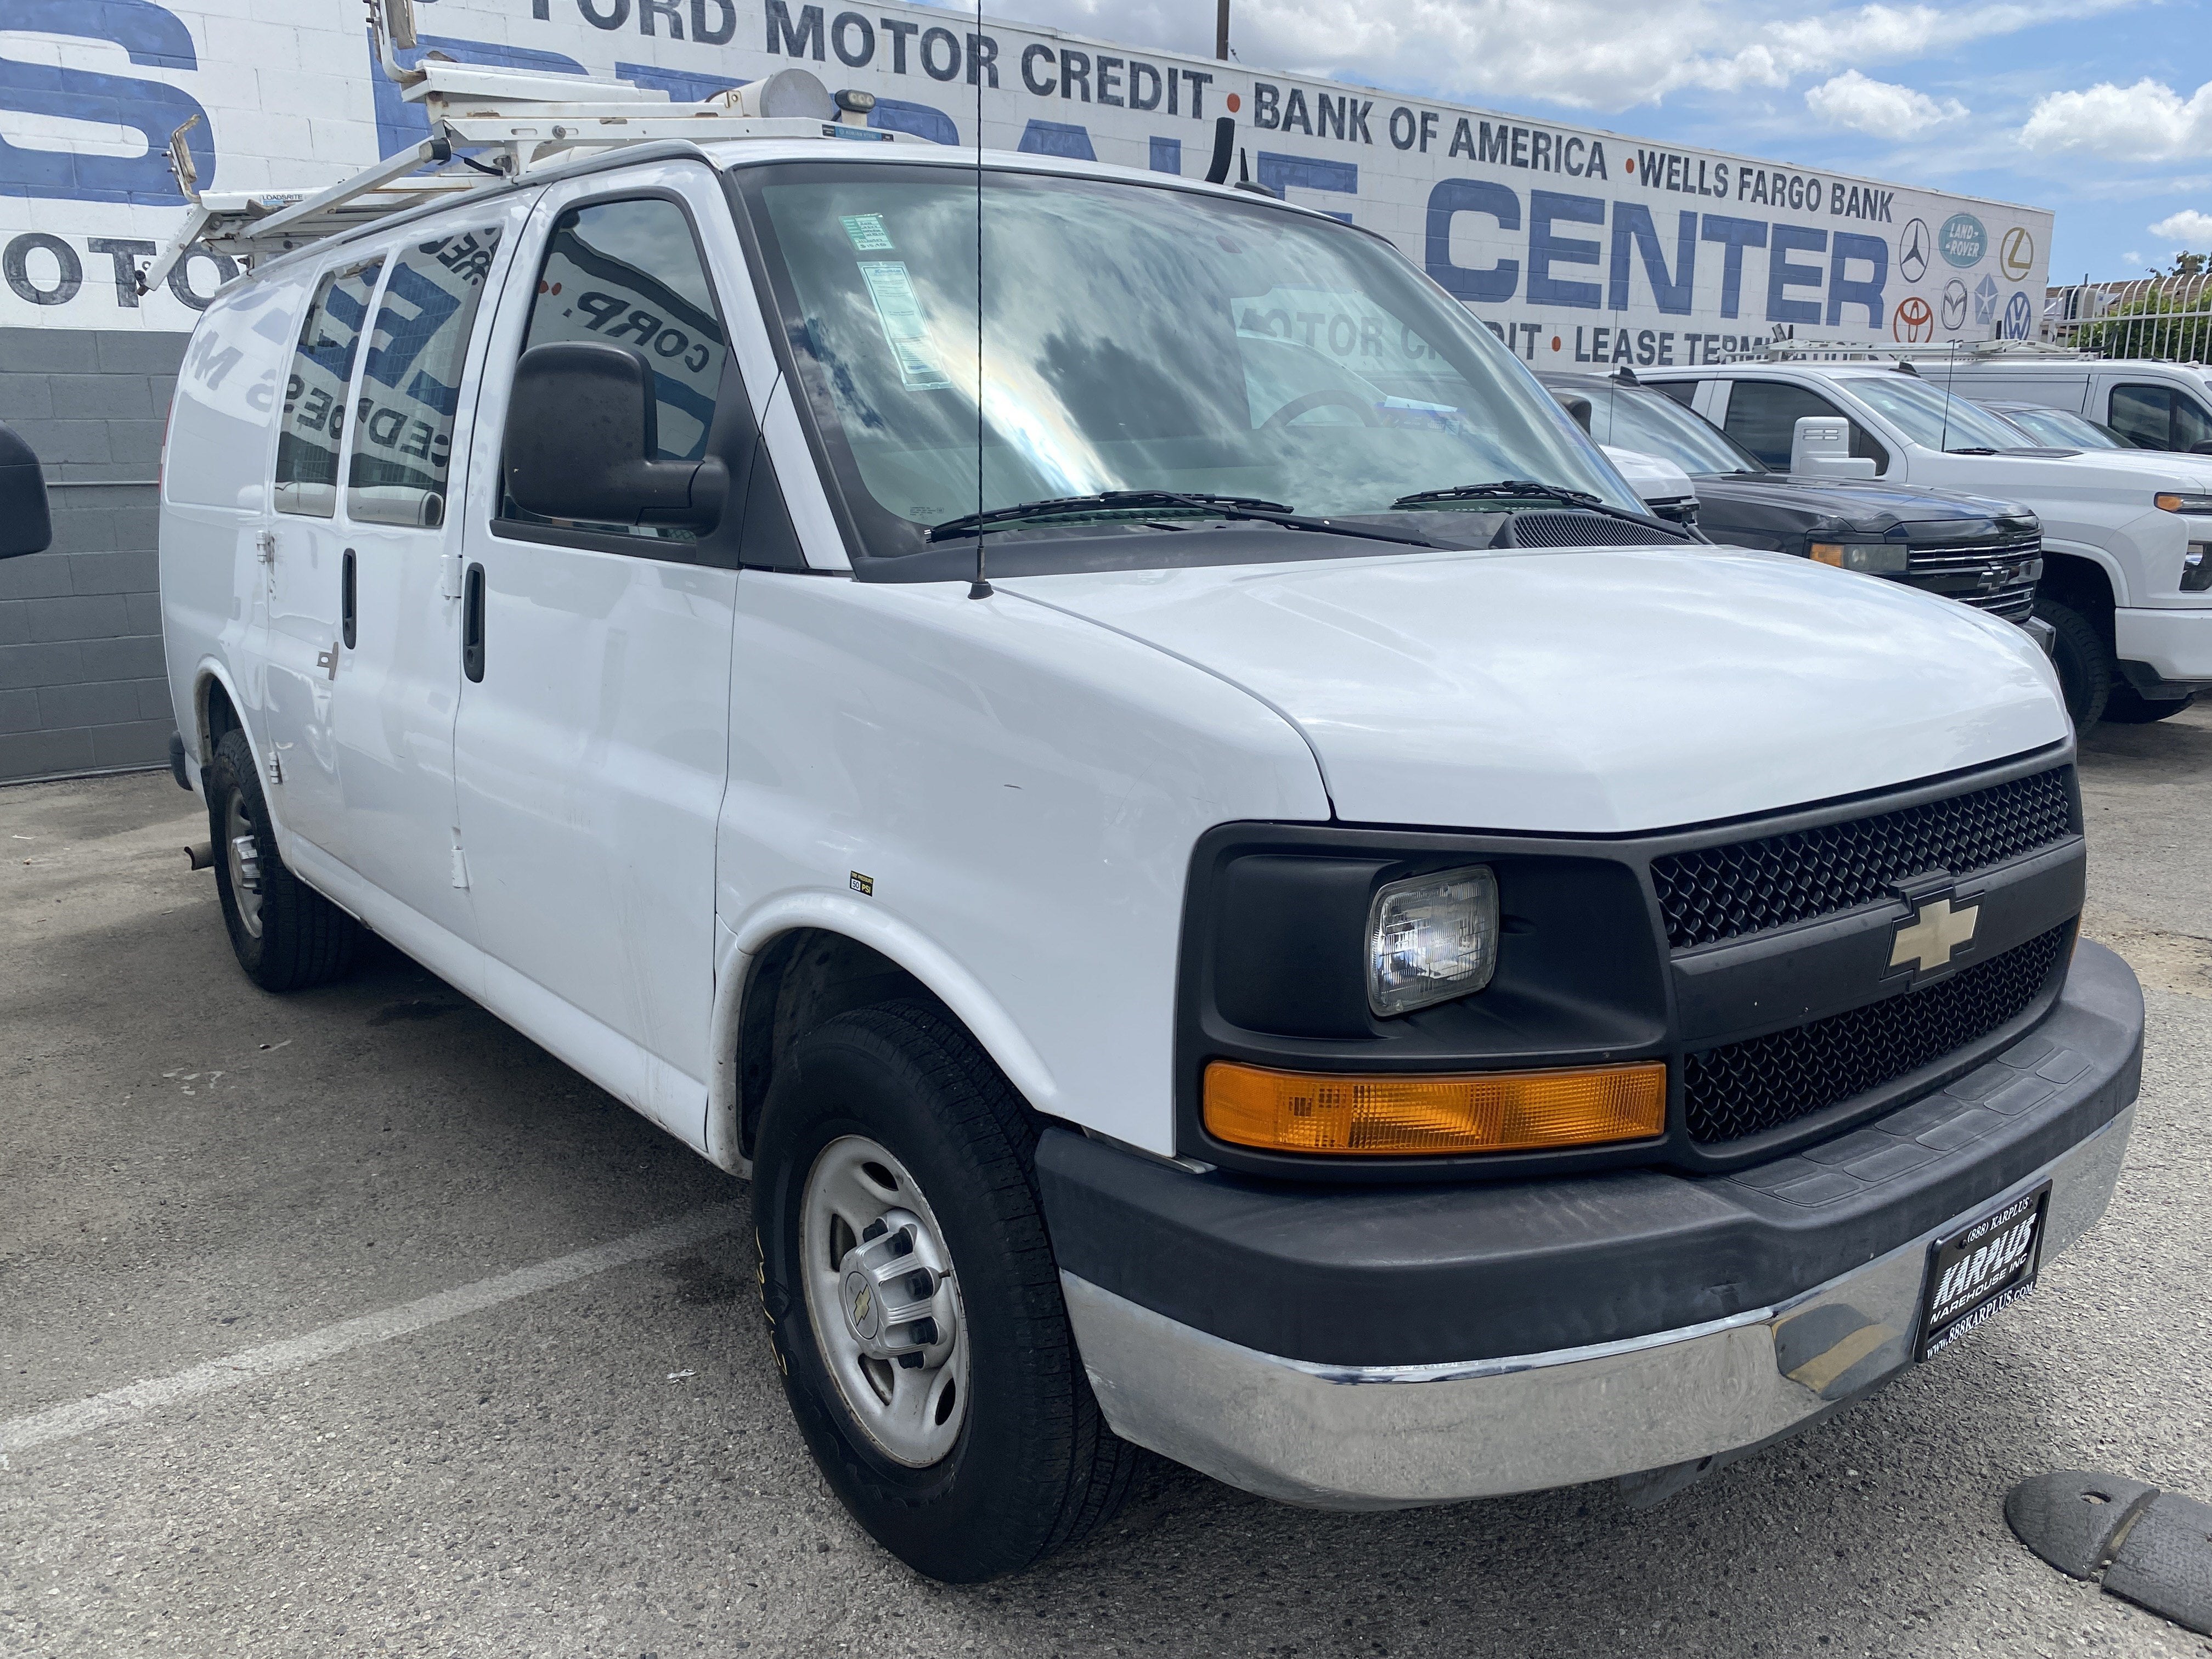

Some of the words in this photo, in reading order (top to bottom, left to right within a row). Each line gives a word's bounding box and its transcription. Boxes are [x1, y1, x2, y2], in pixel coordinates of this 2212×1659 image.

[533, 0, 736, 45] RD
[767, 0, 999, 88] MOTOR
[1021, 43, 1212, 119] CREDIT
[1254, 82, 1373, 144] BANK
[1390, 106, 1439, 153] OF
[1448, 117, 1607, 180] AMERICA
[1638, 149, 1728, 198] WELLS
[1738, 167, 1822, 212] FARGO
[1831, 183, 1894, 223] BANK
[1425, 178, 1888, 329] CENTER
[1575, 326, 1674, 365] LEASE
[853, 881, 860, 889] 50
[862, 884, 871, 893] PSI
[1967, 1222, 1989, 1243] (888)
[1990, 1197, 2030, 1231] KARPLUS
[1932, 1212, 2036, 1310] KARPLUS
[2008, 1253, 2027, 1273] INC
